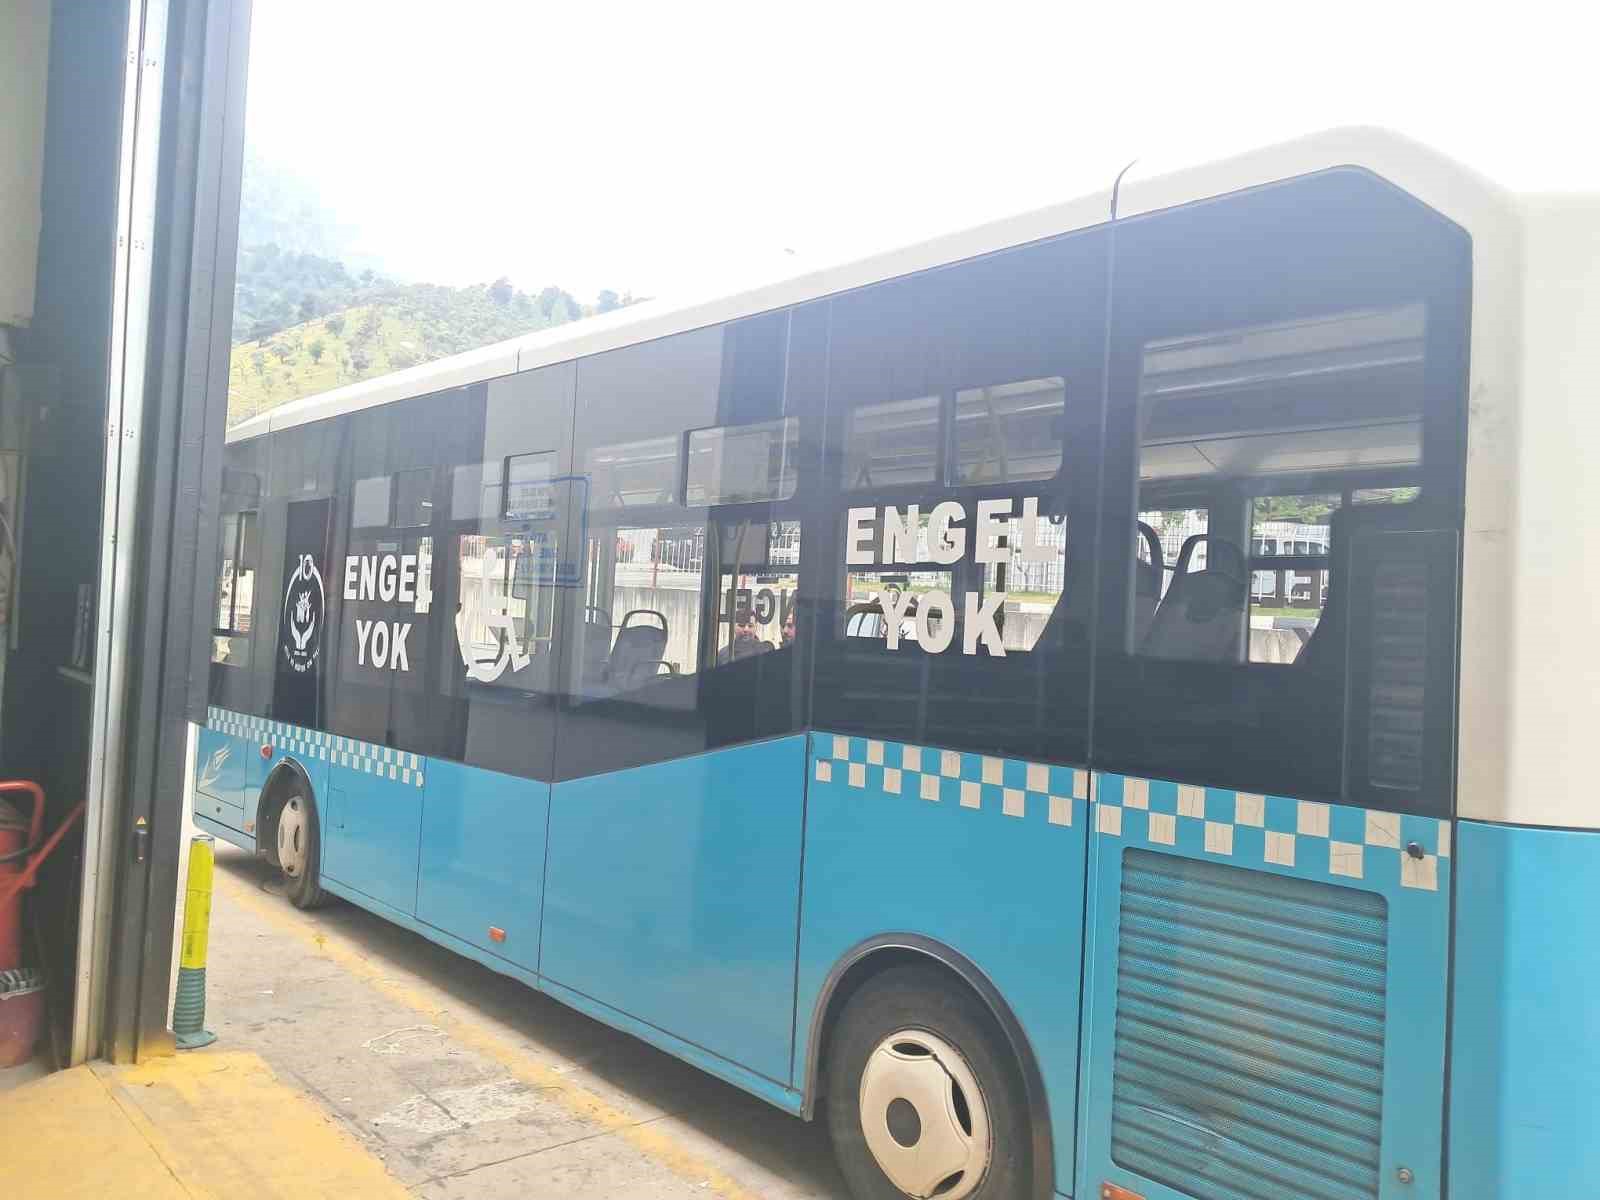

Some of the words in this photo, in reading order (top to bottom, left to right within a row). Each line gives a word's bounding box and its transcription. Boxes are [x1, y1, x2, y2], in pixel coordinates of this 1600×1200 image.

[847, 497, 1057, 564] ENGEL
[344, 555, 432, 603] ENGEL
[356, 620, 412, 671] YOK
[878, 591, 1007, 657] YOK
